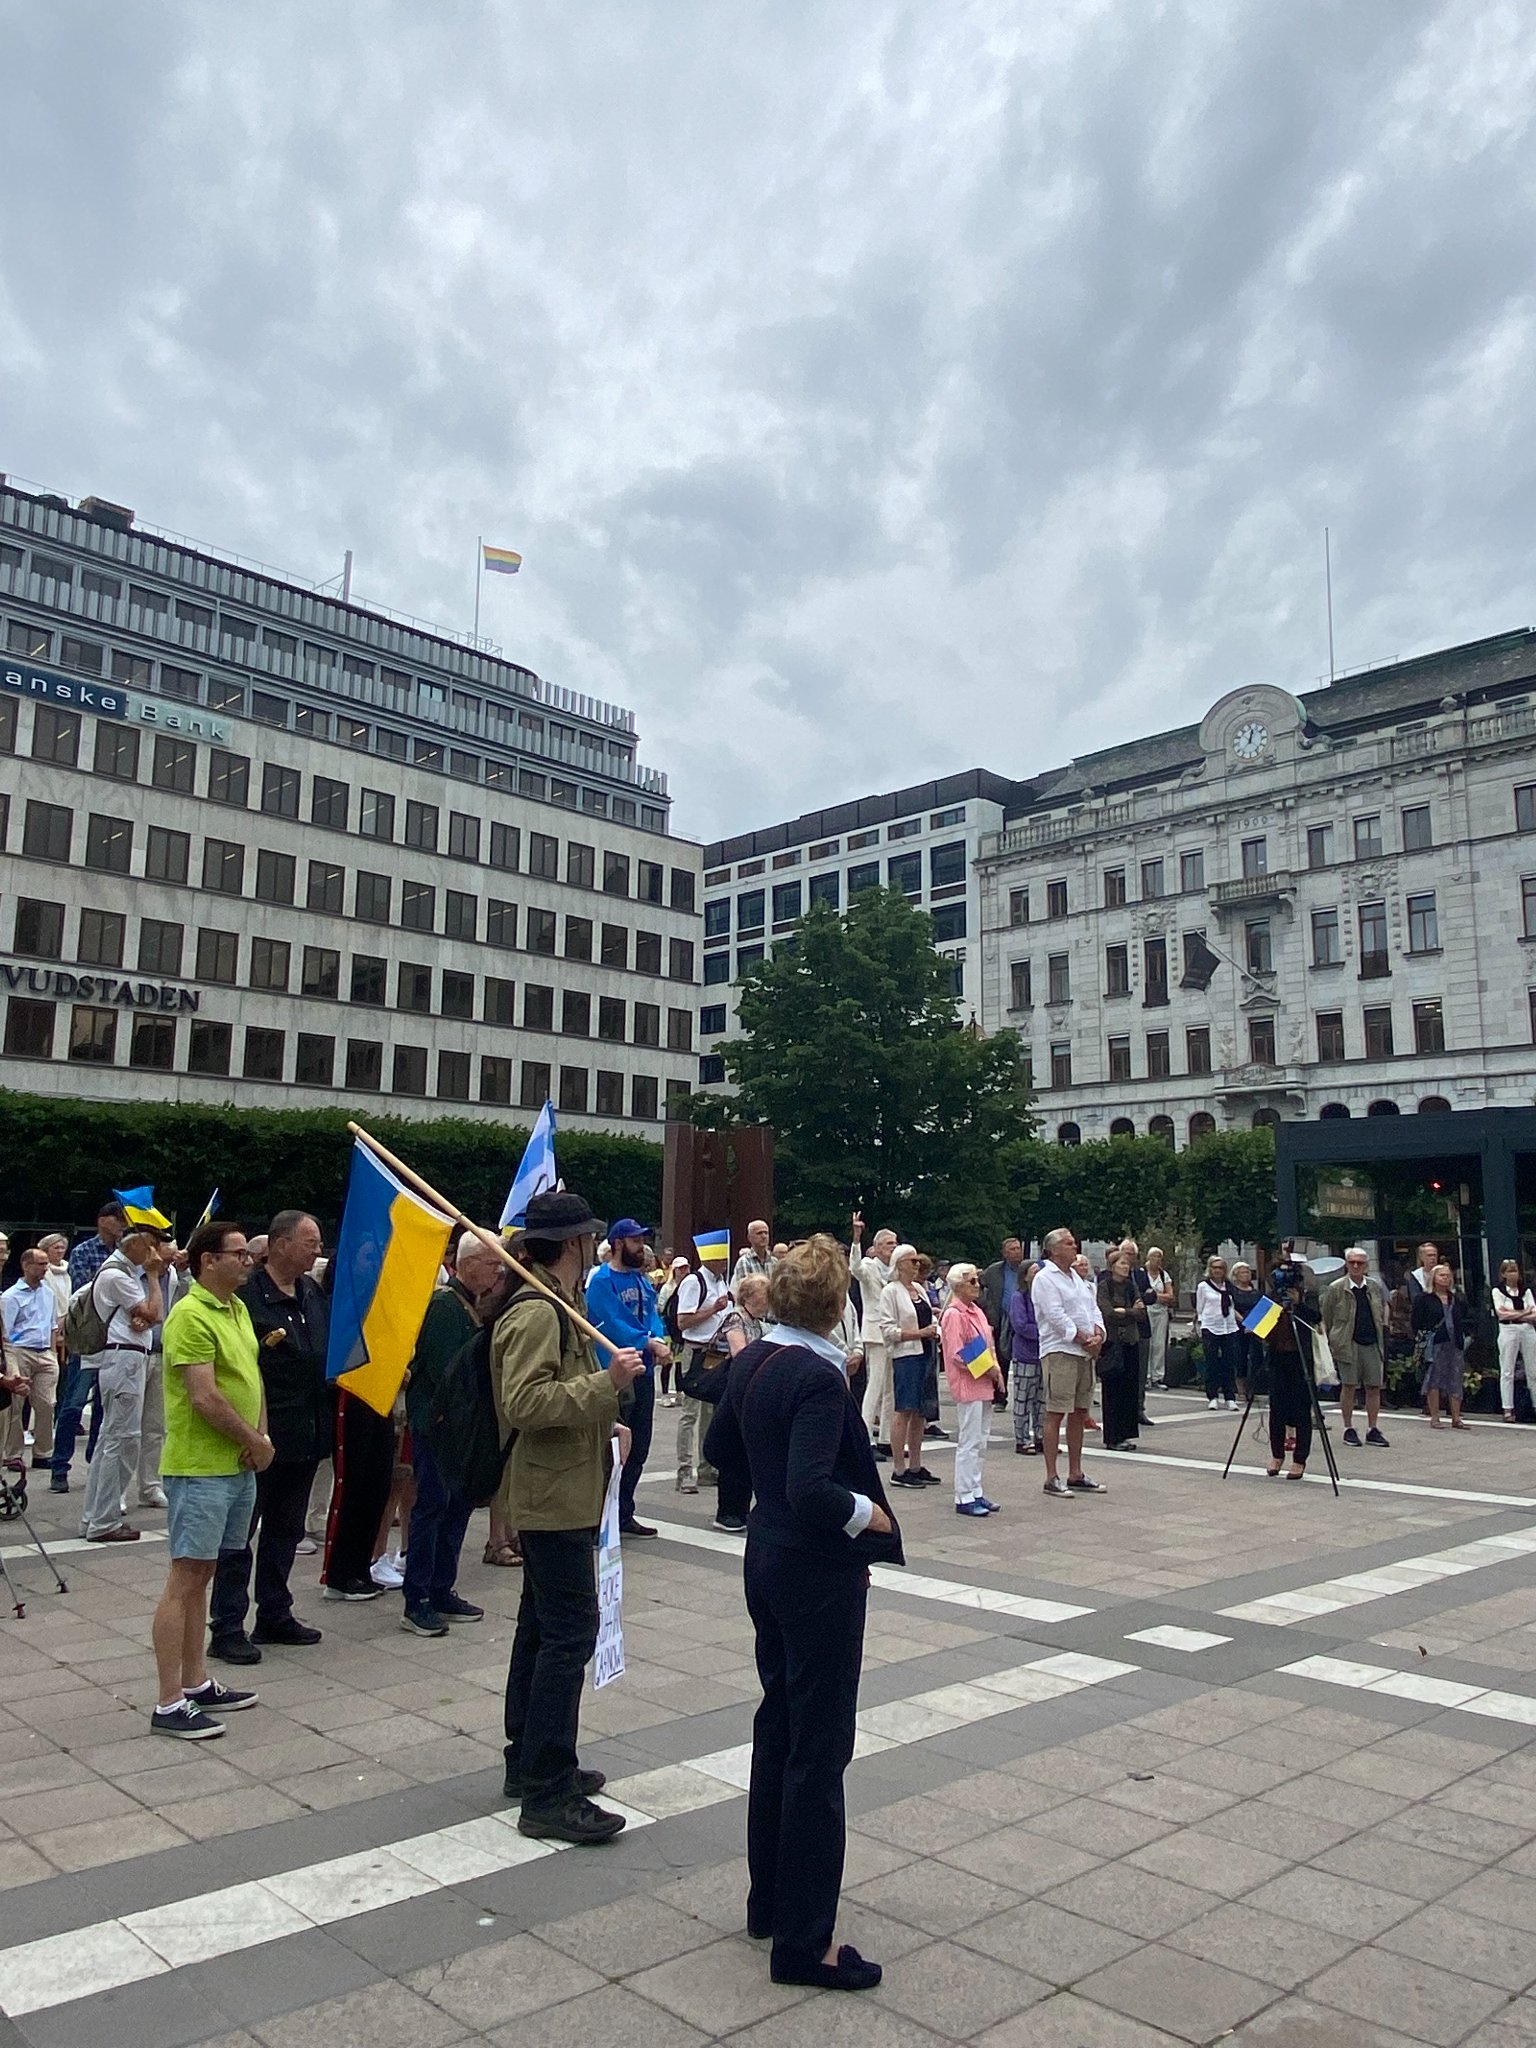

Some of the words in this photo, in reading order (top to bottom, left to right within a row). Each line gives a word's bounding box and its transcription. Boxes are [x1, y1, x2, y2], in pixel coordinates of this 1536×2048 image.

[5, 670, 117, 711] anske
[140, 703, 225, 741] Bank
[0, 963, 202, 1012] VUDSTADEN
